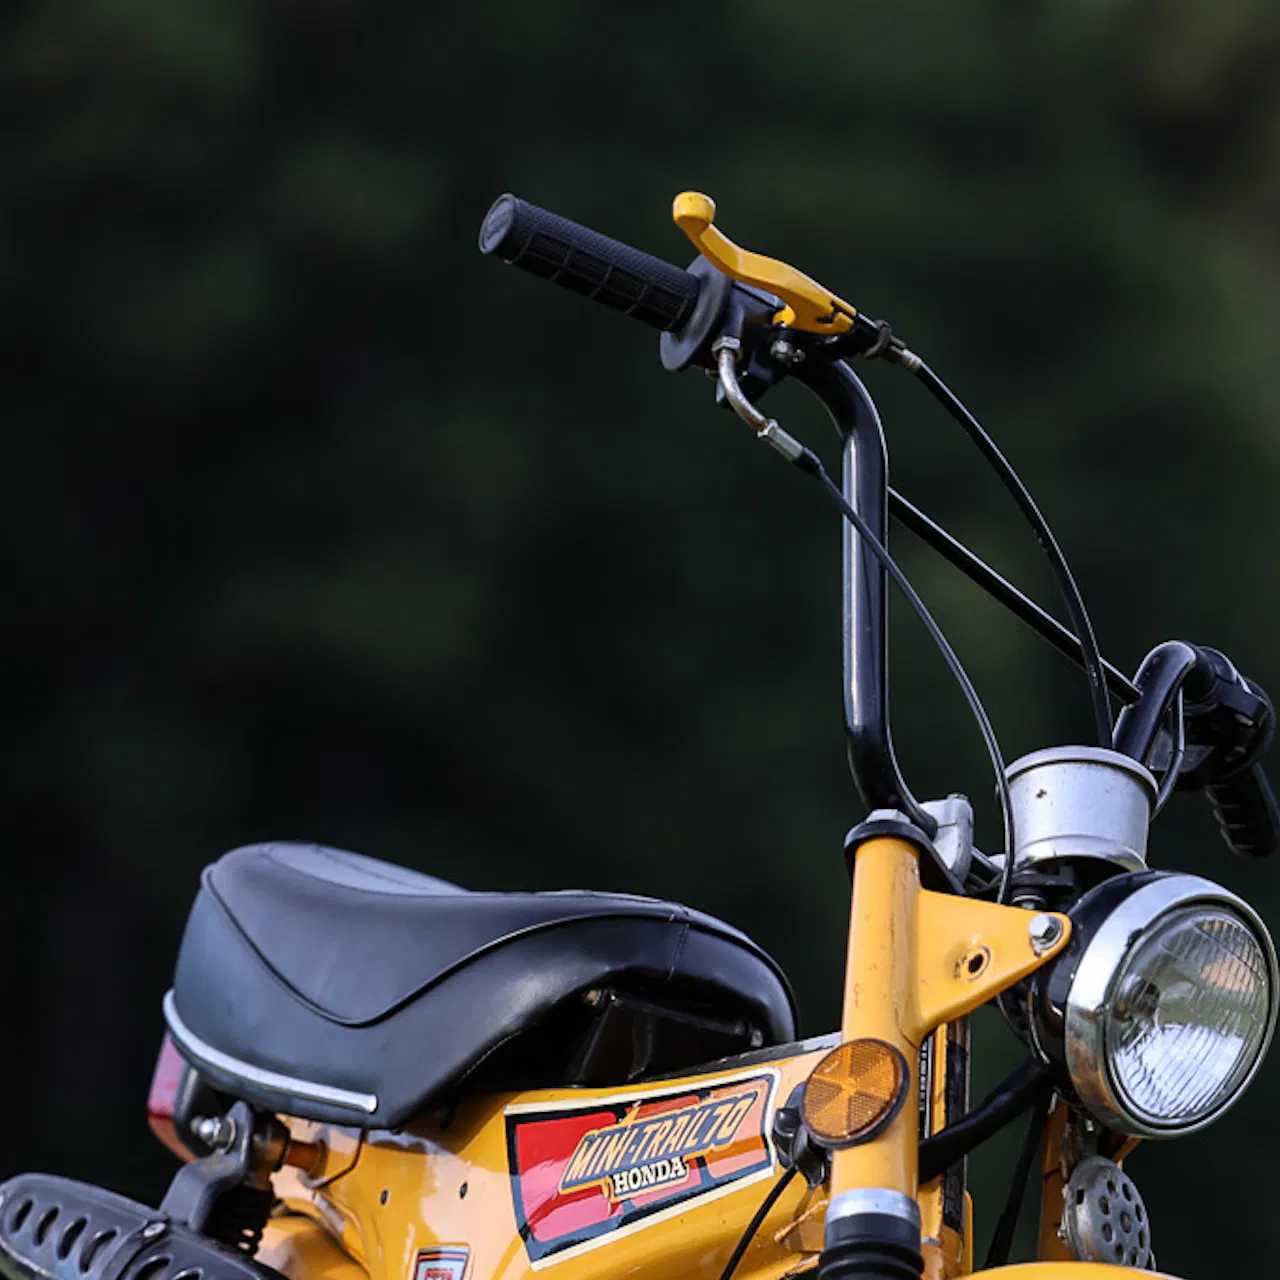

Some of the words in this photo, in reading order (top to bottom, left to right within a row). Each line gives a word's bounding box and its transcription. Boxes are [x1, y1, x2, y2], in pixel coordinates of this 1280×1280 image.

[565, 1106, 708, 1182] MINI-TRAIL
[702, 1096, 756, 1144] 70
[612, 1156, 687, 1194] HONDA
